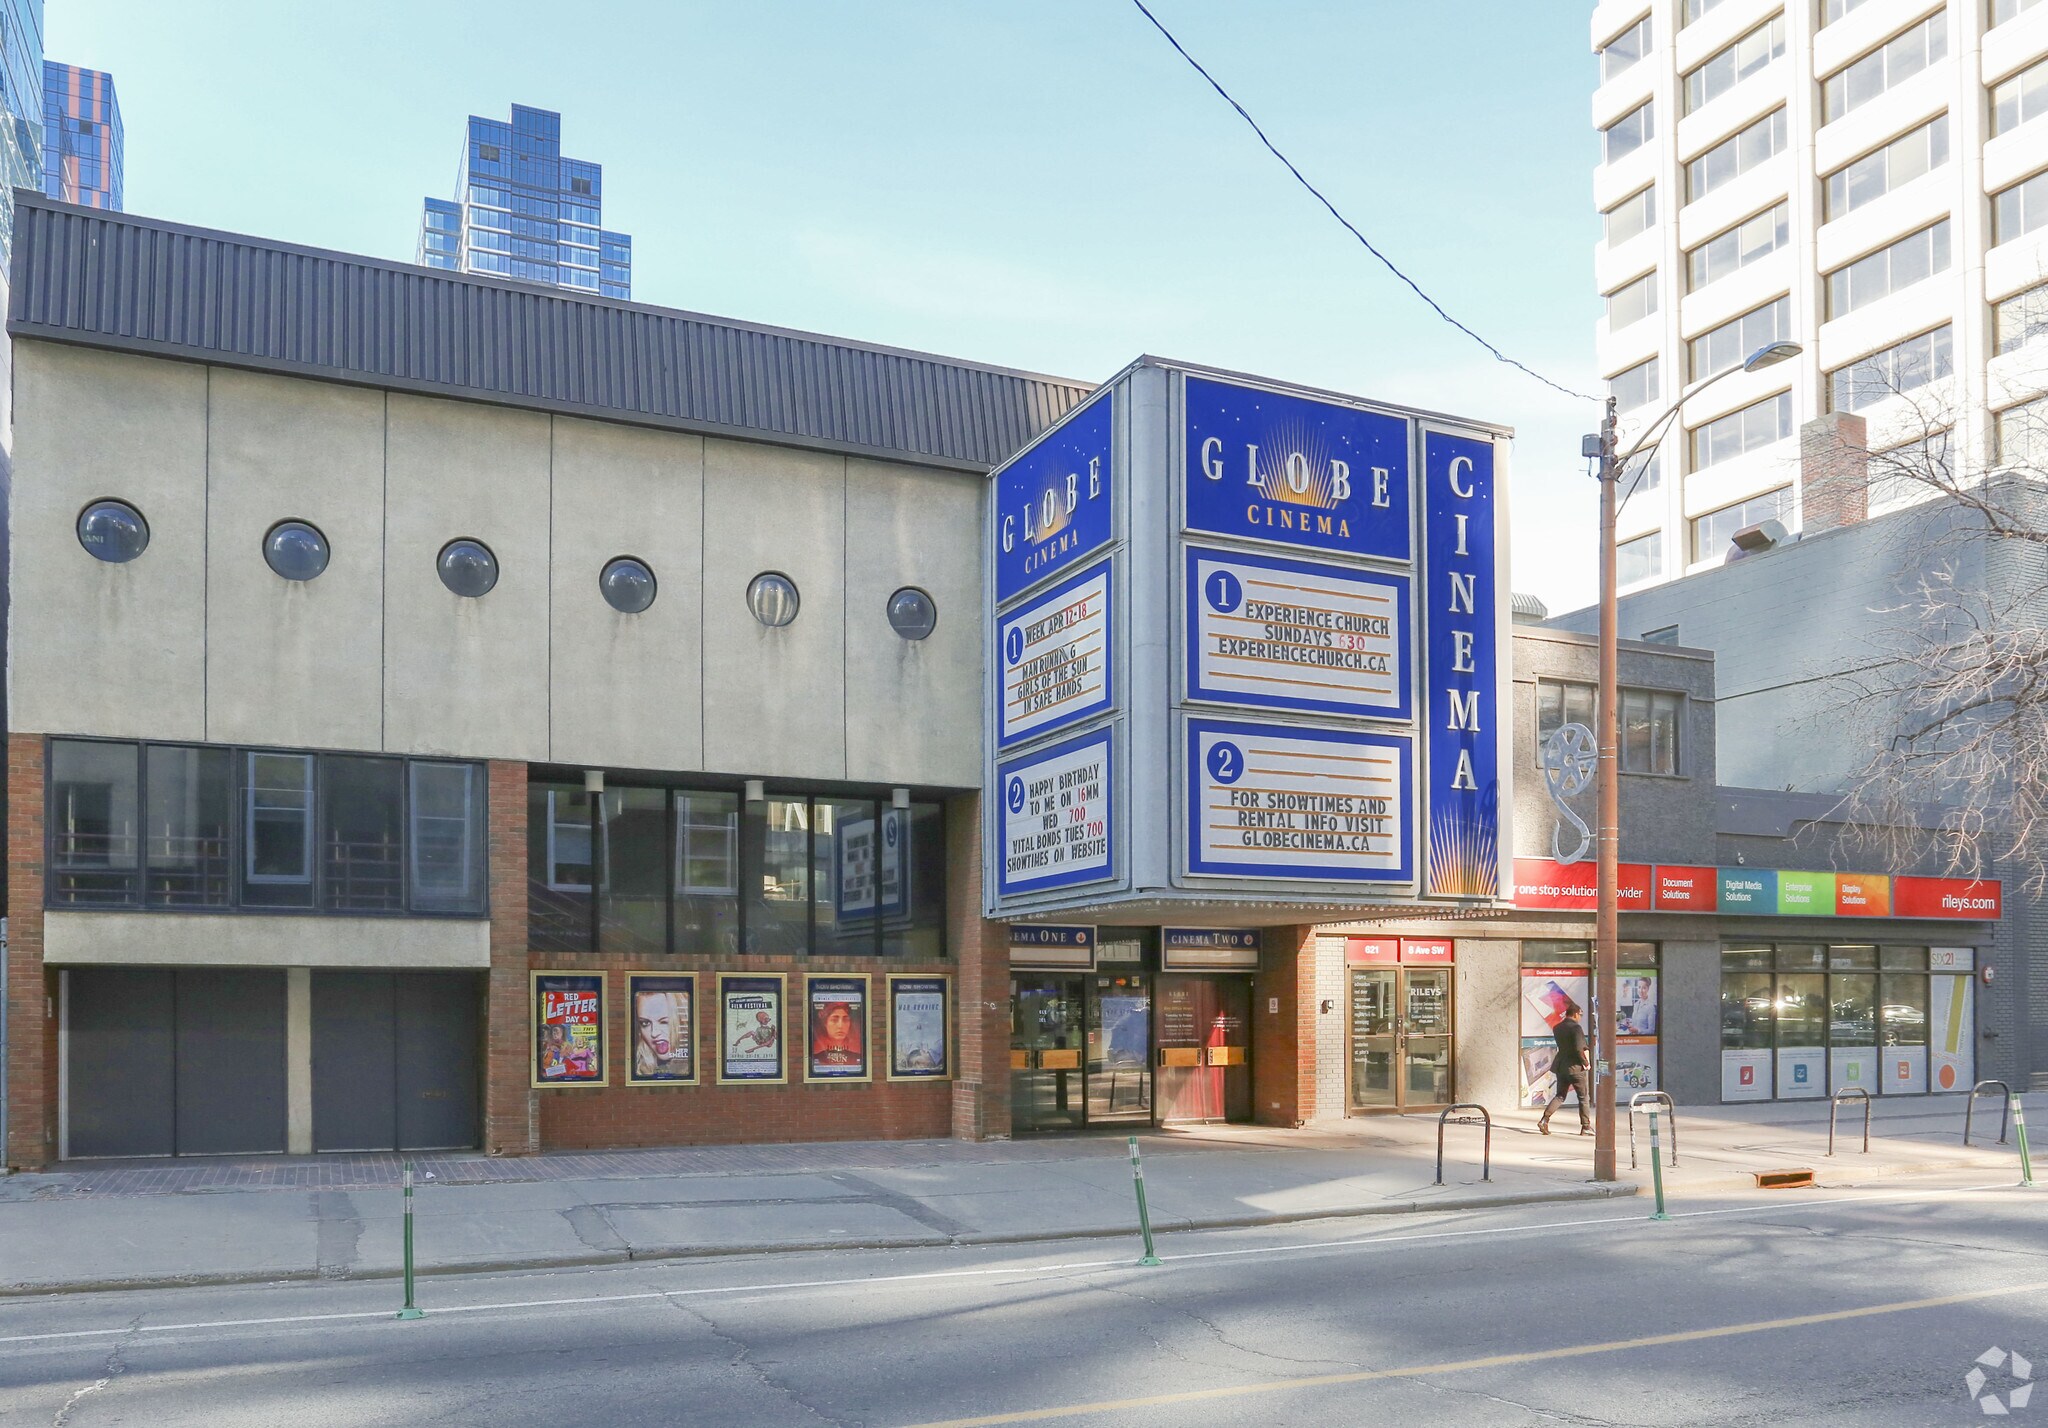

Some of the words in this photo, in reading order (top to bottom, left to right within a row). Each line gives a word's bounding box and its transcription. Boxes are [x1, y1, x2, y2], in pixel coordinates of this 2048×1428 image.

[1201, 436, 1390, 508] GLOBE
[1002, 456, 1101, 553] GLOBE
[1247, 504, 1350, 538] CINEMA
[1025, 528, 1078, 574] CINEMA
[1219, 578, 1230, 607] 1
[1025, 624, 1045, 644] WEEK
[1049, 615, 1064, 634] APR
[1066, 603, 1087, 625] 12-18
[1246, 602, 1332, 629] EXPERIENCE
[1336, 616, 1389, 635] CHURCH
[1446, 455, 1481, 791] CINEMA
[1011, 634, 1018, 659] 1
[1265, 624, 1332, 647] SUNDAYS
[1338, 634, 1365, 651] 630
[1219, 637, 1387, 672] EXPERIENCECHURCH.CA
[1018, 680, 1039, 699] GIRLS
[1042, 673, 1051, 689] OF
[1054, 664, 1068, 682] THE
[1071, 656, 1087, 675] SUN
[1022, 661, 1040, 680] MAN
[1024, 697, 1032, 714] IN
[1034, 689, 1052, 711] SAFE
[1056, 678, 1082, 701] HANDS
[1218, 749, 1233, 777] 2
[1029, 777, 1054, 799] HAPPY
[1060, 764, 1099, 790] BIRTHDAY
[1013, 782, 1020, 808] 2
[1030, 801, 1040, 815] TO
[1044, 796, 1055, 812] ME
[1061, 791, 1071, 807] ON
[1078, 783, 1099, 803] 16MM
[1231, 790, 1260, 808] FOR
[1267, 792, 1353, 813] SHOWTIMES
[1358, 799, 1386, 815] AND
[1042, 814, 1058, 830] WED
[1069, 806, 1086, 824] 700
[1238, 811, 1295, 829] RENTAL
[1304, 814, 1338, 832] INFO
[1345, 816, 1384, 833] VISIT
[1013, 837, 1034, 854] VITAL
[1037, 830, 1061, 849] BONDS
[1065, 824, 1084, 843] TUES
[1087, 821, 1103, 838] 700
[1242, 831, 1370, 851] GLOBECINEMA.CA
[1007, 850, 1048, 873] SHOWTIMES
[1054, 848, 1064, 862] ON
[1071, 838, 1105, 860] WEBSITE
[1519, 885, 1538, 895] one
[1538, 884, 1560, 897] stop
[1662, 878, 1693, 888] Document
[1662, 890, 1690, 900] Solutions
[1725, 880, 1744, 891] Digital
[1745, 881, 1762, 890] Media
[1785, 882, 1812, 893] Enterprise
[1842, 884, 1861, 894] Display
[1725, 892, 1752, 902] Solutions
[1785, 894, 1810, 903] Solutions
[1842, 896, 1866, 904] Solutions
[1942, 894, 1995, 911] rileys.com
[1040, 930, 1067, 942] ONE
[1171, 935, 1210, 945] CINEMA
[1212, 933, 1238, 944] TWO
[1365, 946, 1379, 954] 621
[1415, 946, 1430, 954] Ave
[1431, 946, 1445, 955] SW
[564, 993, 579, 1001] RED
[1410, 988, 1441, 996] RILEYS
[547, 998, 597, 1019] LETTER
